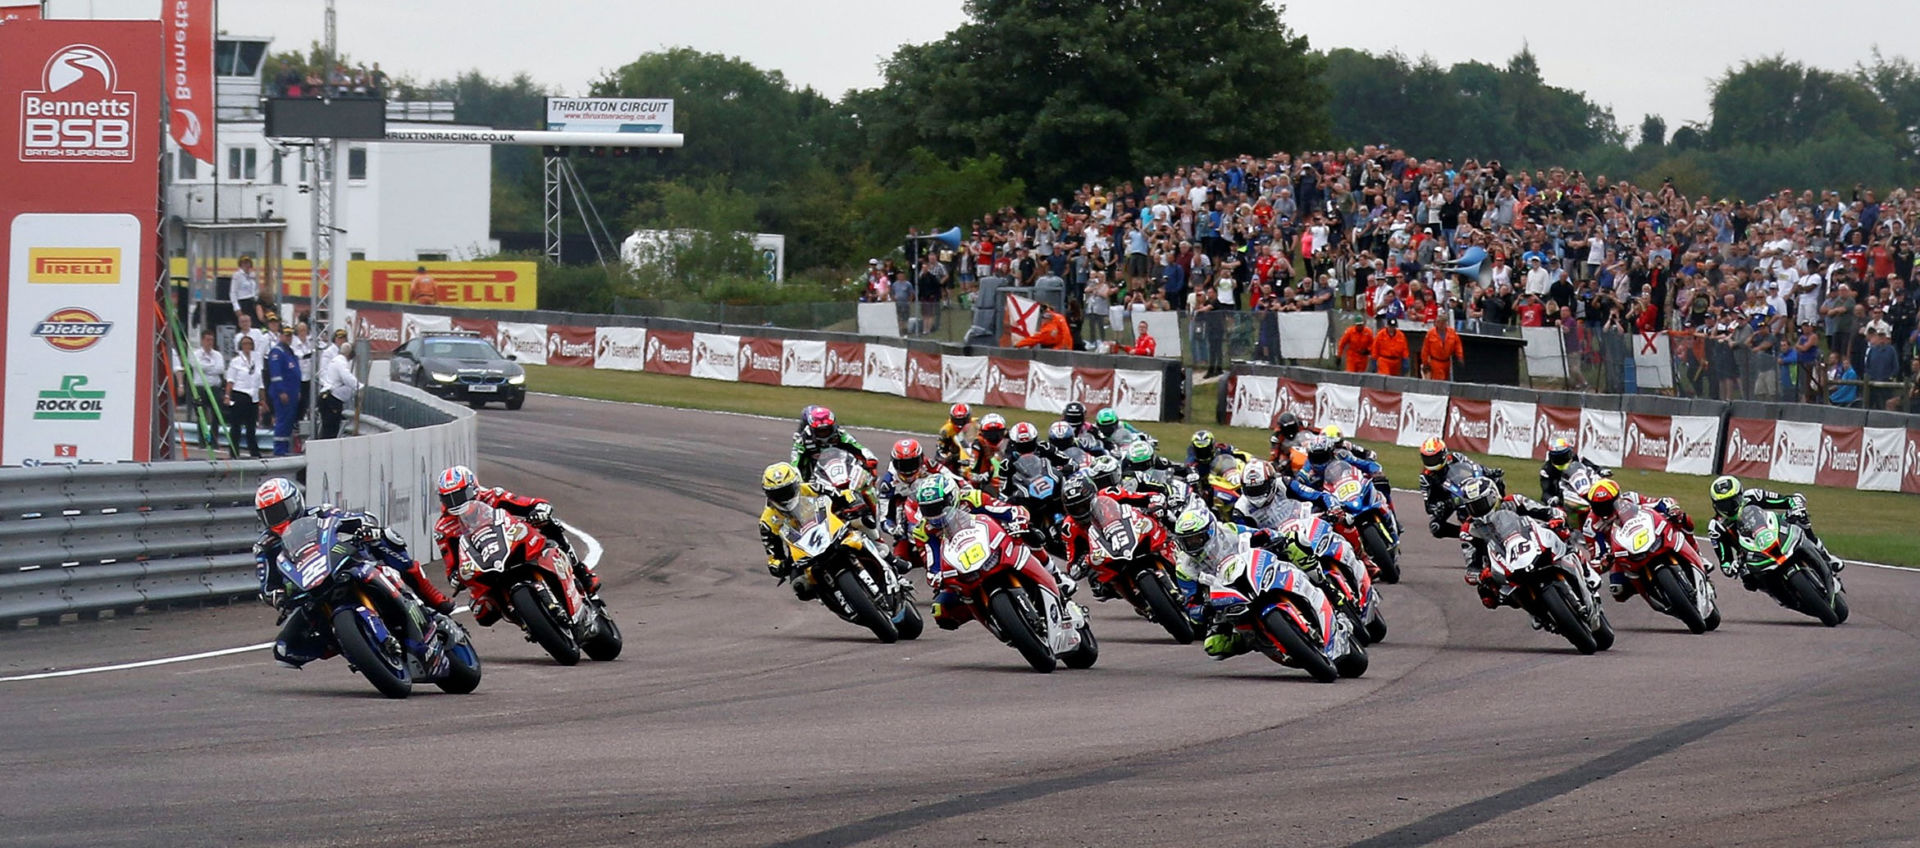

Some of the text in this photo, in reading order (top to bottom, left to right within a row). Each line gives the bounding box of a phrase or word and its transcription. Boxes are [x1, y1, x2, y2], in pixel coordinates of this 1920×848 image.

[26, 97, 130, 117] Bennetts
[552, 101, 669, 112] THRUXTON CIRCUIT
[25, 119, 129, 148] BSB
[385, 131, 516, 142] HRUXTONRACING.CO.UK
[66, 149, 129, 157] SUPERBIKES
[36, 257, 113, 274] PIRELLI
[372, 270, 517, 303] PIELLI
[40, 324, 105, 336] Dickies
[36, 400, 103, 411] ROCK OIL
[61, 446, 70, 456] S
[809, 529, 823, 548] 4
[1112, 531, 1130, 551] 45
[1633, 528, 1649, 551] 6
[481, 541, 499, 562] 25
[957, 543, 986, 571] 18
[1510, 539, 1531, 563] 46
[302, 555, 328, 588] 22
